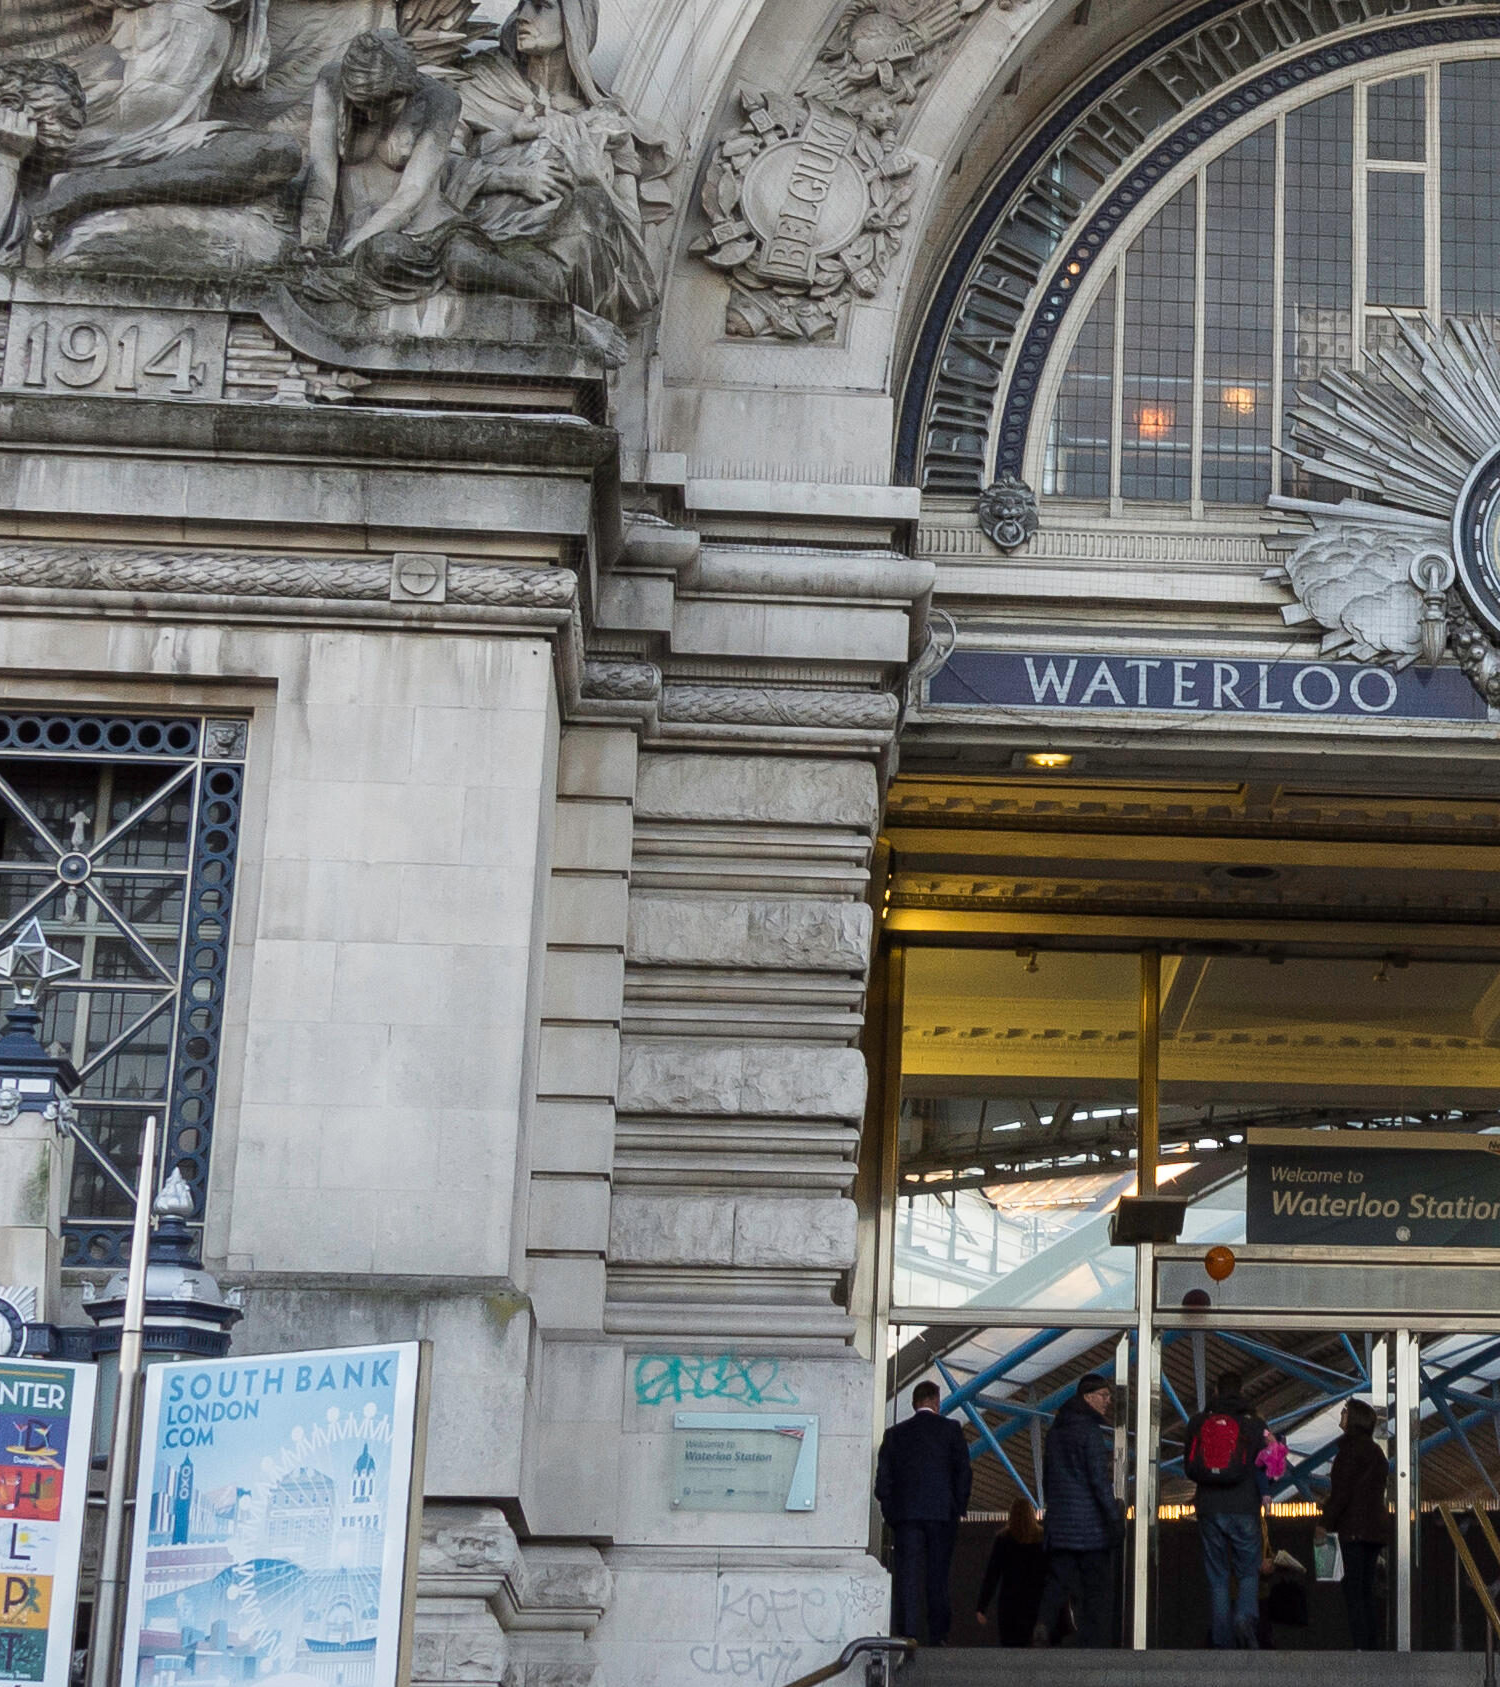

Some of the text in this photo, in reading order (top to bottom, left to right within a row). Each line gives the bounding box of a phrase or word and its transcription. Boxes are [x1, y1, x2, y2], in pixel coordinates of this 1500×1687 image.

[767, 115, 852, 274] BELGIUM
[922, 237, 1046, 494] DEDICATED
[1008, 173, 1086, 235] TO
[1056, 88, 1149, 185] THE
[22, 317, 207, 395] 1914
[1024, 655, 1401, 716] WATERLOO
[1271, 1166, 1364, 1184] Welcome to
[1272, 1190, 1401, 1219] Waterloo
[168, 1359, 391, 1402] SOUTH BANK
[166, 1399, 260, 1426] LONDON
[162, 1427, 214, 1450] .COM
[684, 1450, 773, 1463] Waterloo Station
[180, 1465, 191, 1500] OXO
[9, 1522, 30, 1560] L
[4, 1576, 30, 1614] P
[0, 1632, 23, 1671] T
